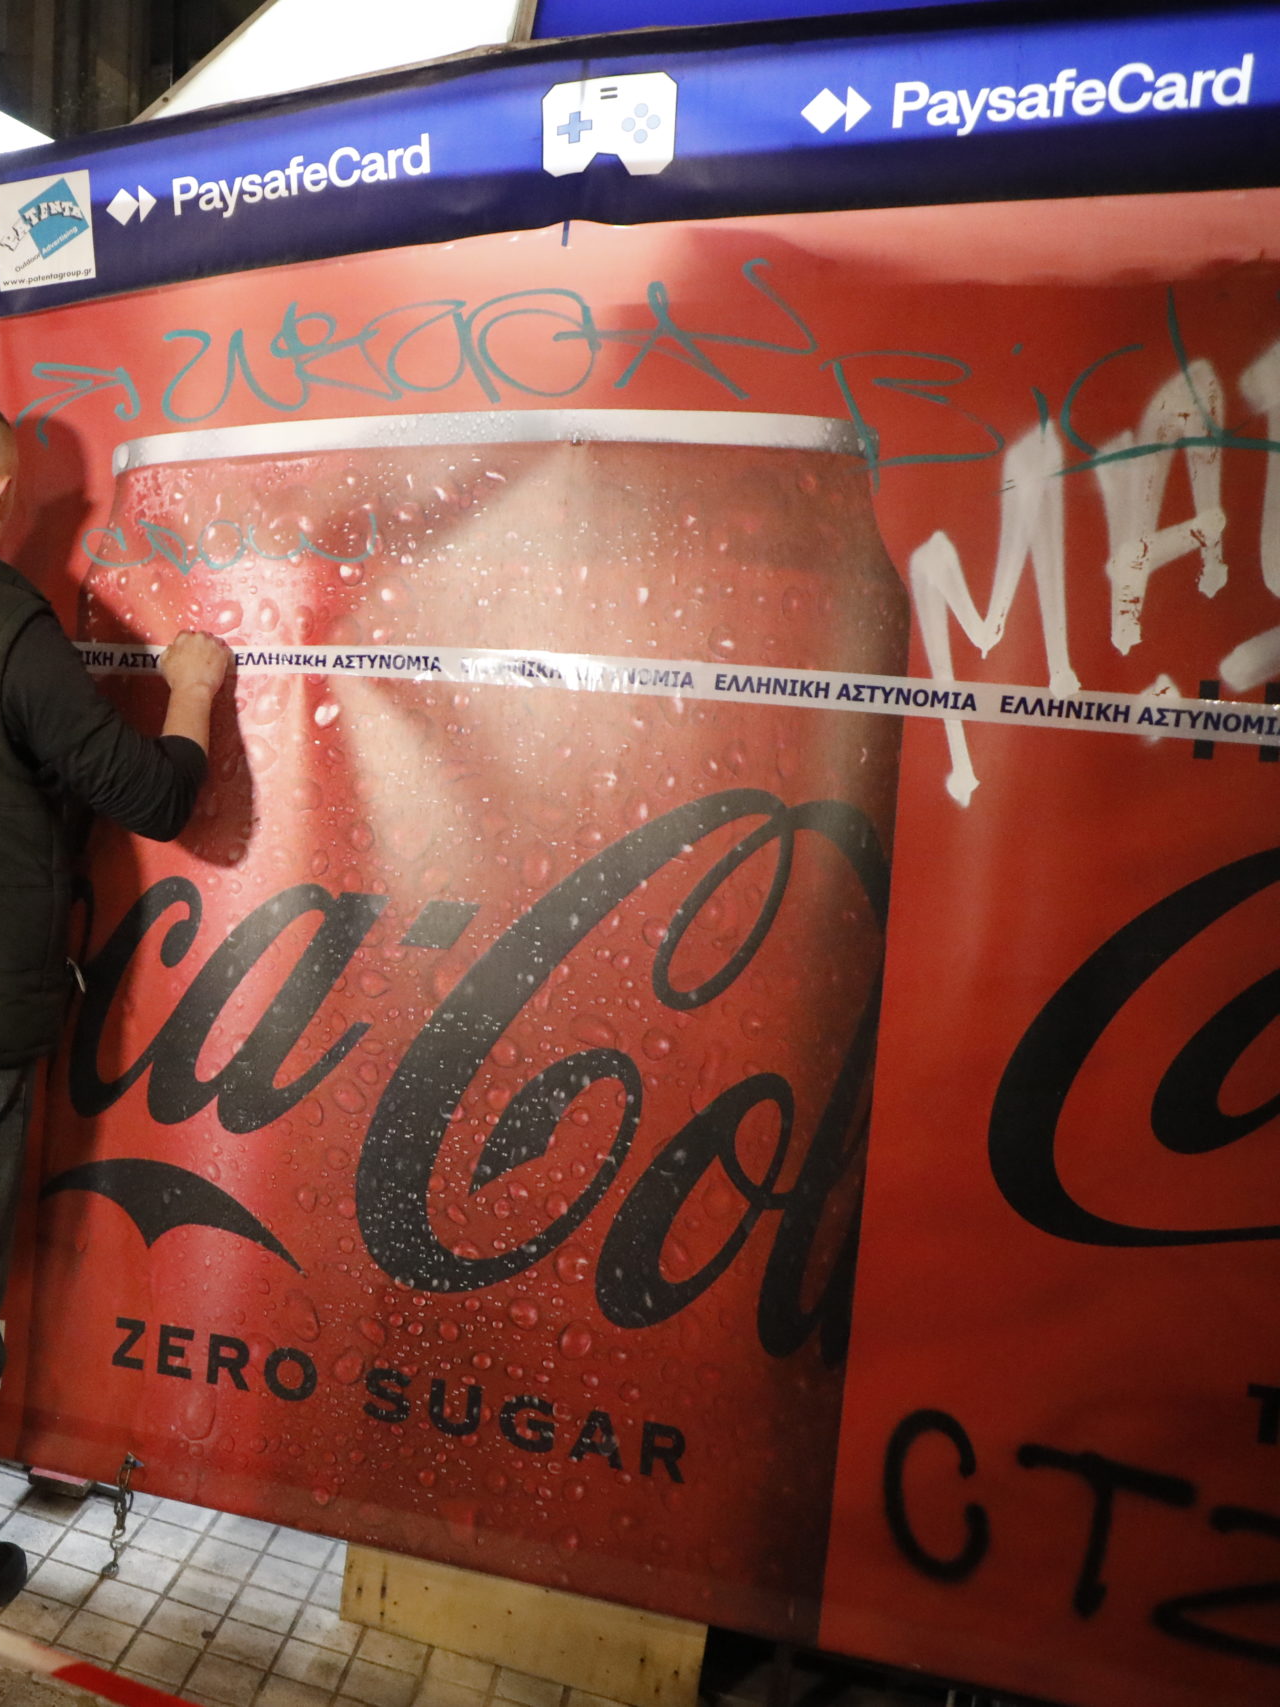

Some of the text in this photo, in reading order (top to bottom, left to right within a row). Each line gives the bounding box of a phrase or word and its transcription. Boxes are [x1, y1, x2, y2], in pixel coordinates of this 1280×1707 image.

[890, 53, 1255, 136] PaysafeCard
[172, 133, 432, 217] PaysafeCard
[2, 267, 93, 287] www.patentagroup.gr
[14, 226, 78, 273] Outdoor Advertising
[235, 652, 328, 668] ΕΛΛΗΝΙΚΗ
[332, 653, 443, 673] ΑΣΤΥΝΟΜΙΑ
[715, 673, 831, 700] ΕΛΛΗΝΙΚΗ
[836, 682, 978, 712] ΑΣΤΥΝΟΜΙΑ
[999, 695, 1129, 725] ΕΛΛΗΝΙΚΗ
[110, 1315, 688, 1485] ZERO SUGAR
